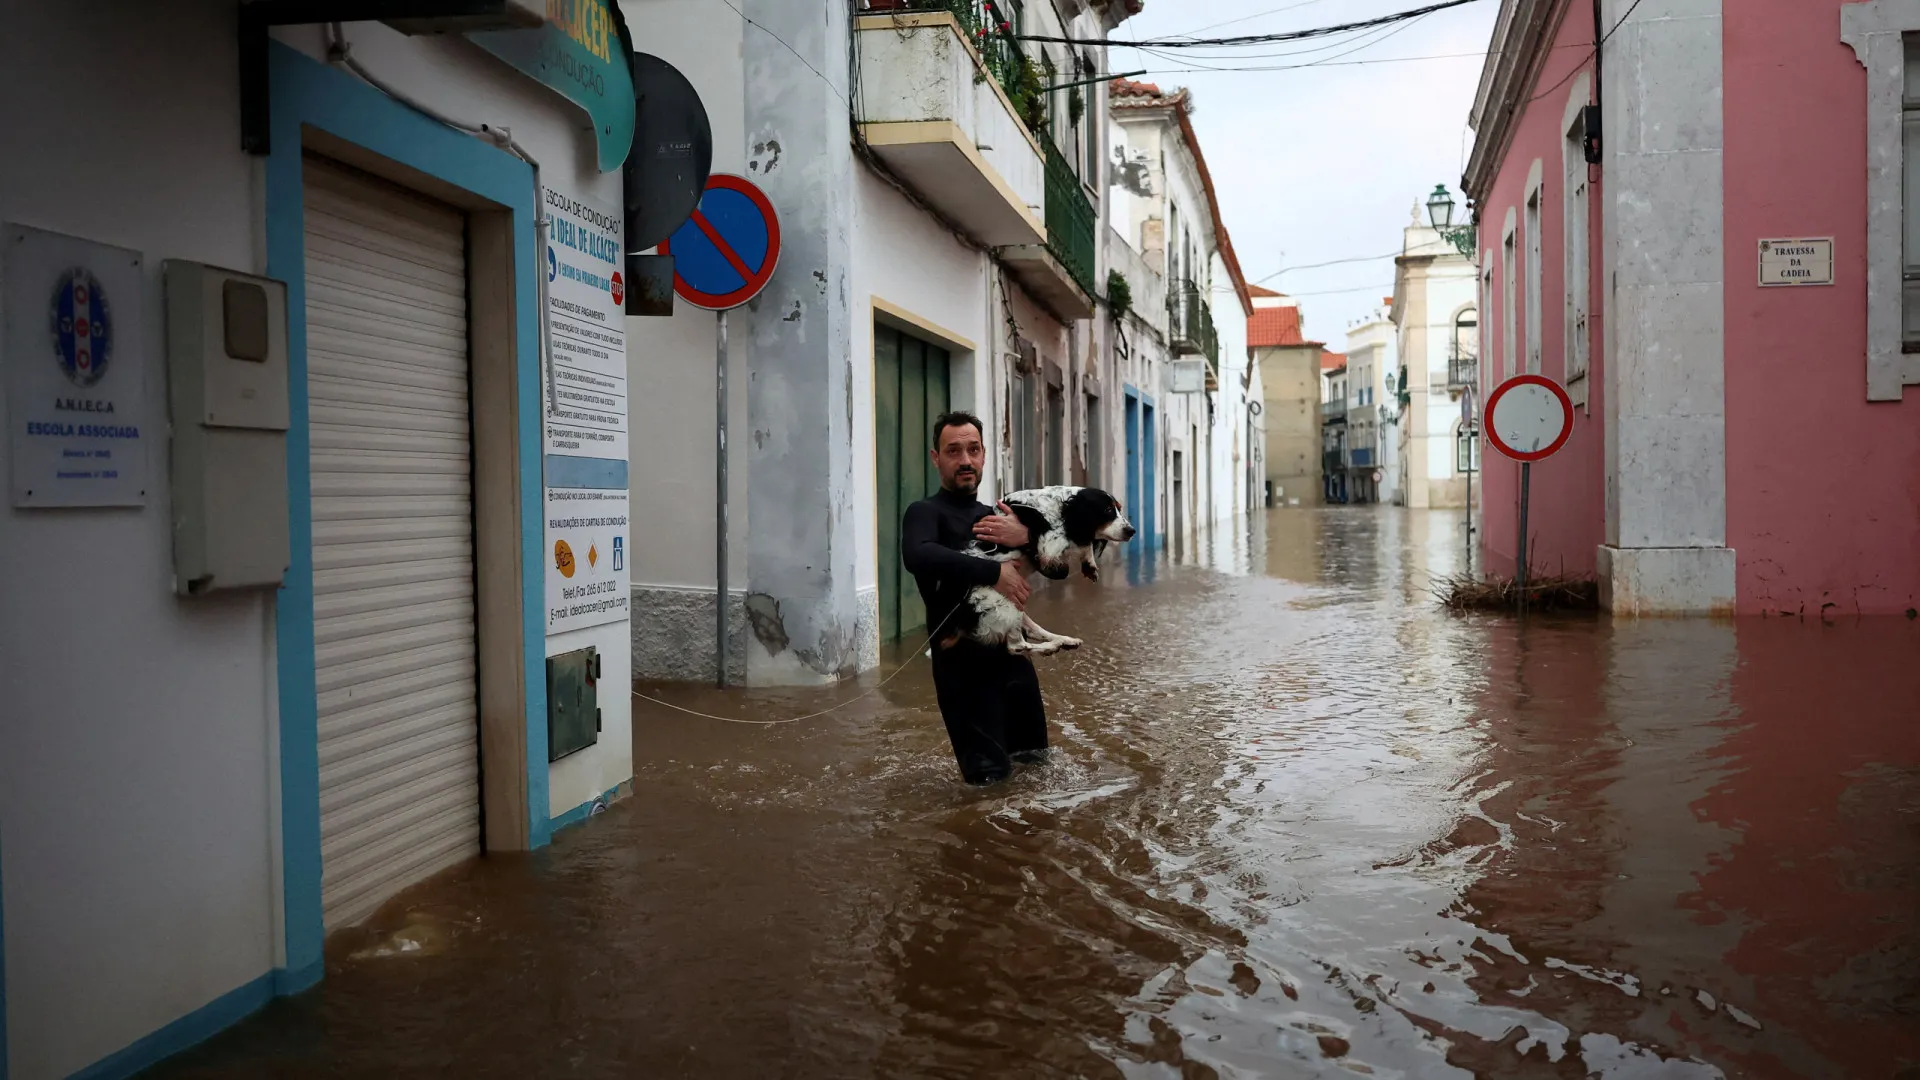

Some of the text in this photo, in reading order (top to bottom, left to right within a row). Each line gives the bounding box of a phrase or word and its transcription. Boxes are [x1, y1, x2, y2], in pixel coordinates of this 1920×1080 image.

[546, 189, 618, 234] ESCOLA DE CONDUÇÃO
[557, 217, 577, 249] IDEAL
[578, 226, 588, 253] DE
[1774, 247, 1815, 256] TRAVESSA
[1790, 258, 1801, 266] DA
[1780, 269, 1811, 278] CADEIA
[612, 281, 623, 297] STOP
[575, 304, 581, 315] DE
[581, 306, 606, 322] PAGAMENTO
[553, 340, 562, 349] ULAS
[27, 421, 140, 439] ESCOLA ASSOCIADA
[587, 583, 596, 596] 265
[596, 581, 606, 594] 612
[606, 580, 616, 592] 022
